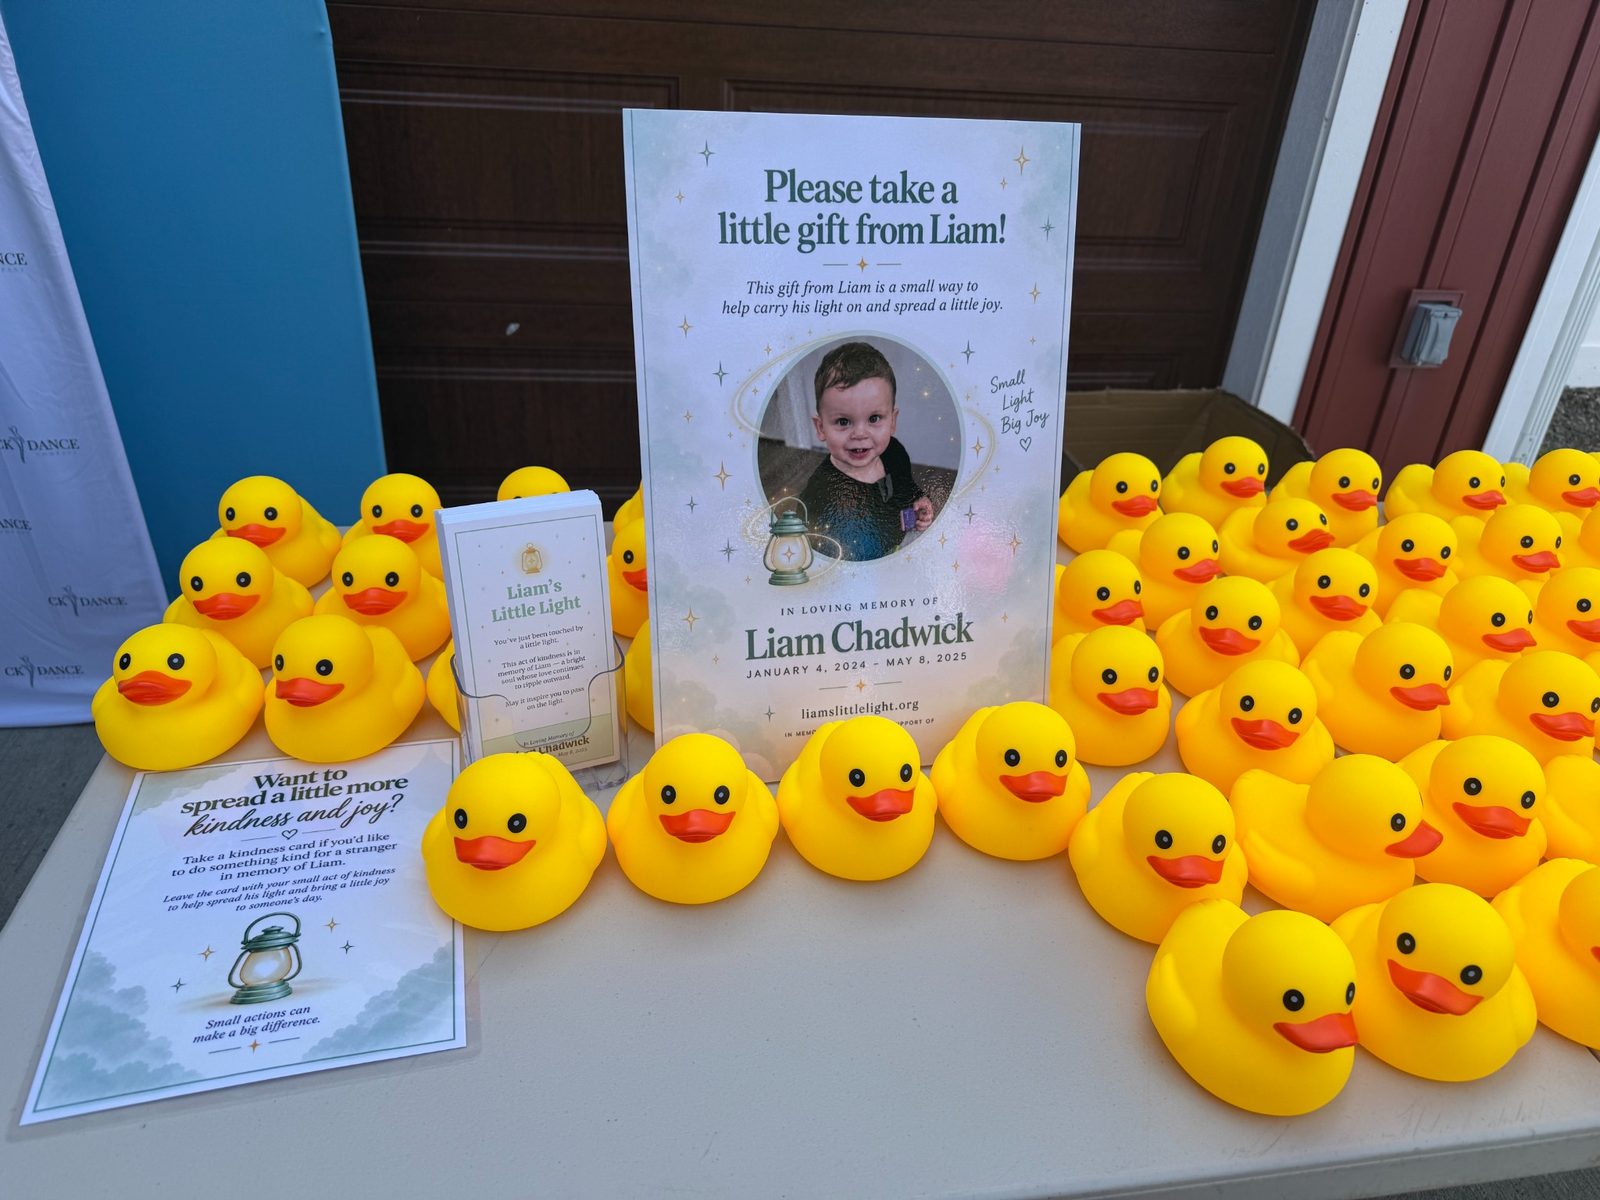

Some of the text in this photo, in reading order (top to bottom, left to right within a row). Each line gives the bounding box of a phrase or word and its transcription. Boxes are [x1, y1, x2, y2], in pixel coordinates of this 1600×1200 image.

[764, 170, 958, 204] Please take a
[718, 212, 1006, 253] little gift from Liam!
[747, 280, 978, 297] This gift from Liam is a small way to
[722, 298, 1002, 317] help carry his light on and spread a little joy.
[991, 369, 1025, 393] Small
[1003, 388, 1034, 413] Light
[1001, 409, 1050, 434] Big Joy
[27, 438, 80, 451] DANCE
[507, 579, 562, 600] Liam’s
[80, 597, 128, 607] DANCE
[491, 596, 581, 622] Little Light
[781, 597, 938, 616] IN LOVING MEMORY OF
[518, 634, 530, 642] just
[548, 626, 574, 636] touched
[745, 612, 974, 660] Liam Chadwick
[498, 668, 526, 677] memory
[566, 656, 586, 664] bright
[537, 652, 566, 662] kindness
[746, 666, 808, 678] JANUARY
[816, 664, 828, 674] 4,
[834, 660, 866, 672] 2024
[886, 656, 912, 667] MAY
[919, 655, 930, 665] 8,
[937, 652, 968, 662] 2025
[37, 665, 84, 676] DANCE
[501, 676, 516, 685] soul
[516, 673, 537, 682] whose
[552, 664, 584, 674] continues
[523, 680, 542, 689] ripple
[526, 694, 549, 703] inspire
[550, 691, 562, 699] you
[570, 686, 584, 694] pass
[801, 700, 920, 720] liamslittlelight.org
[538, 736, 590, 754] Chadwick
[254, 769, 348, 790] Want to
[180, 778, 408, 816] spread a little more
[184, 793, 404, 838] kindness and joy?
[172, 868, 186, 877] to
[188, 866, 206, 875] do
[209, 855, 278, 871] something
[282, 852, 310, 863] kind
[314, 849, 332, 860] for
[346, 842, 398, 854] stranger
[182, 854, 214, 865] Take
[228, 844, 286, 859] kindness
[288, 840, 316, 852] card
[319, 838, 328, 848] if
[368, 833, 390, 842] like
[220, 858, 346, 880] in memory of Liam.
[163, 866, 396, 902] Leave the card with your small act of kindness
[181, 900, 204, 911] help
[206, 894, 242, 908] spread
[244, 892, 260, 902] his
[262, 888, 286, 900] light
[288, 886, 308, 895] and
[311, 882, 338, 894] bring
[350, 878, 372, 887] little
[373, 876, 390, 887] joy
[236, 904, 246, 912] to
[302, 893, 323, 904] day.
[206, 1006, 310, 1030] Small actions can
[193, 1030, 226, 1043] make
[240, 1025, 258, 1036] big
[261, 1017, 320, 1032] difference.
